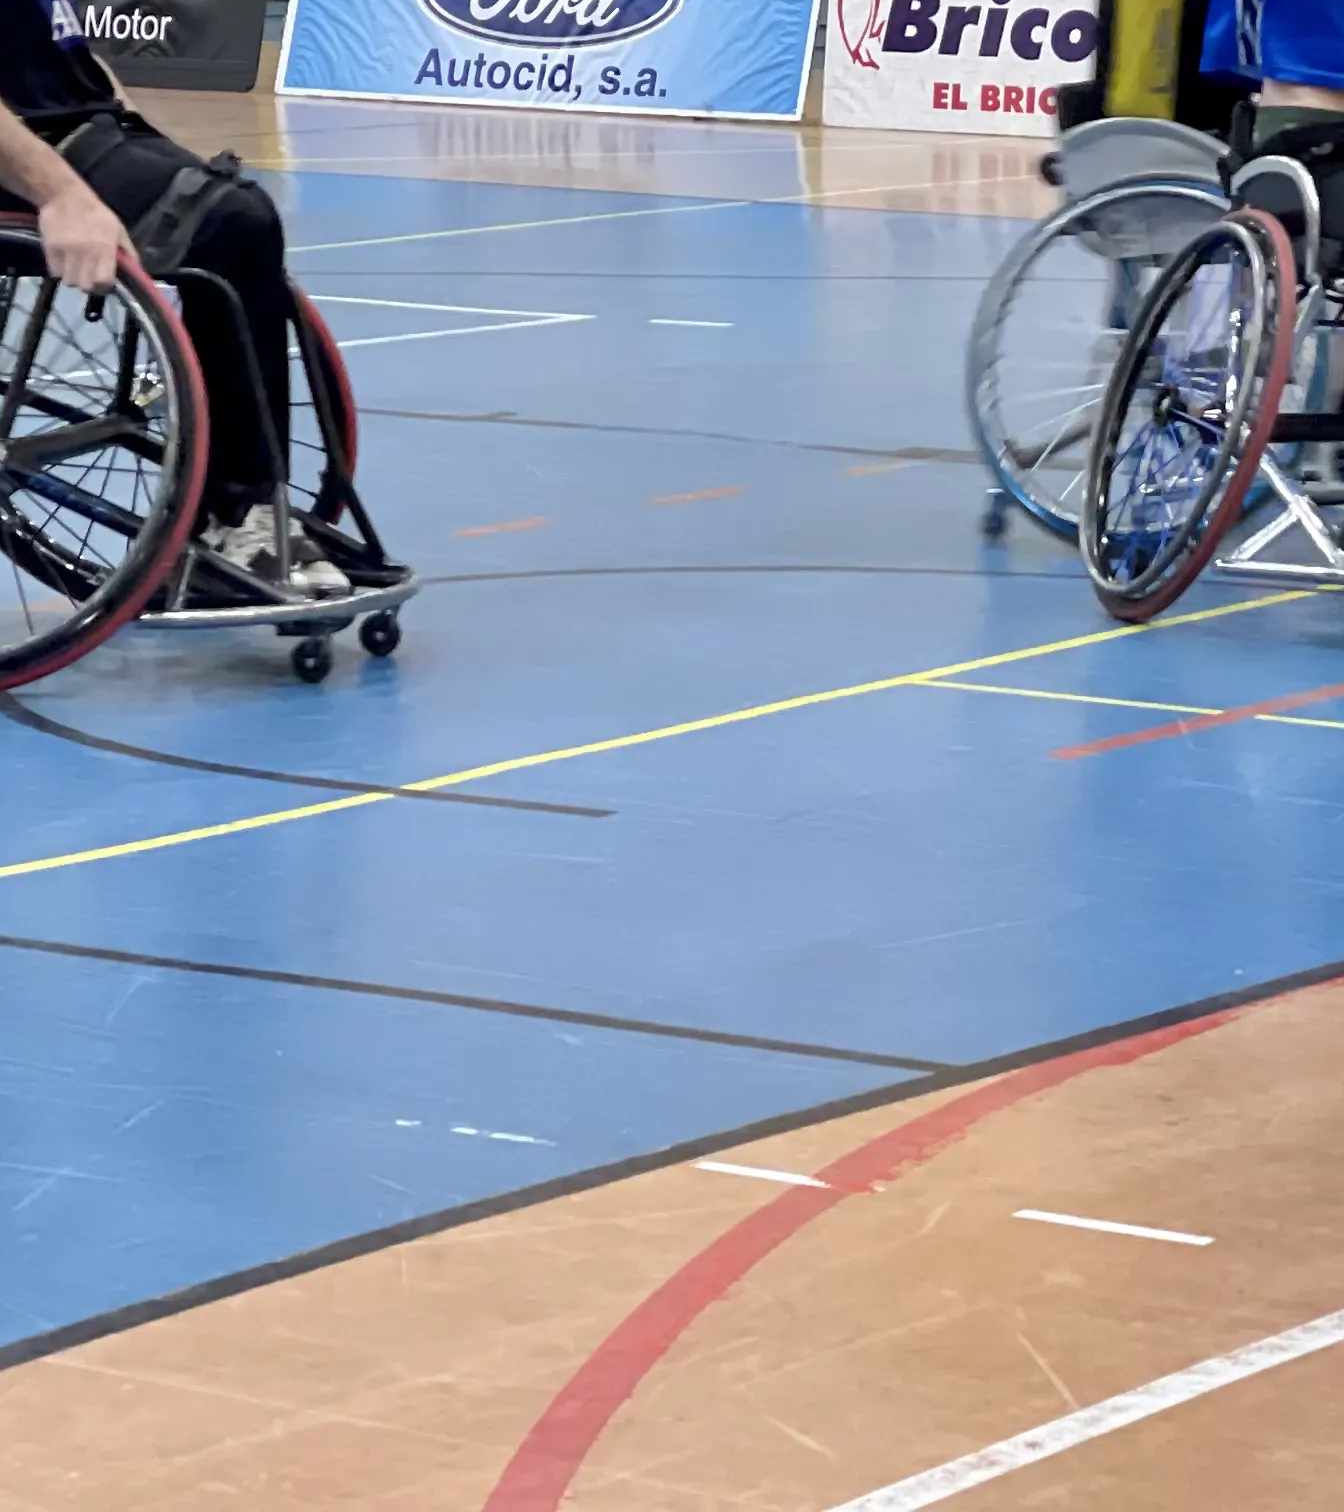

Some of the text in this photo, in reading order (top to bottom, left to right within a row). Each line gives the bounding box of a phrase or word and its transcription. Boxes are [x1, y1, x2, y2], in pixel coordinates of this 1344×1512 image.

[85, 5, 172, 40] Motor
[414, 48, 667, 100] Autocid, s.a.
[933, 82, 968, 110] EL
